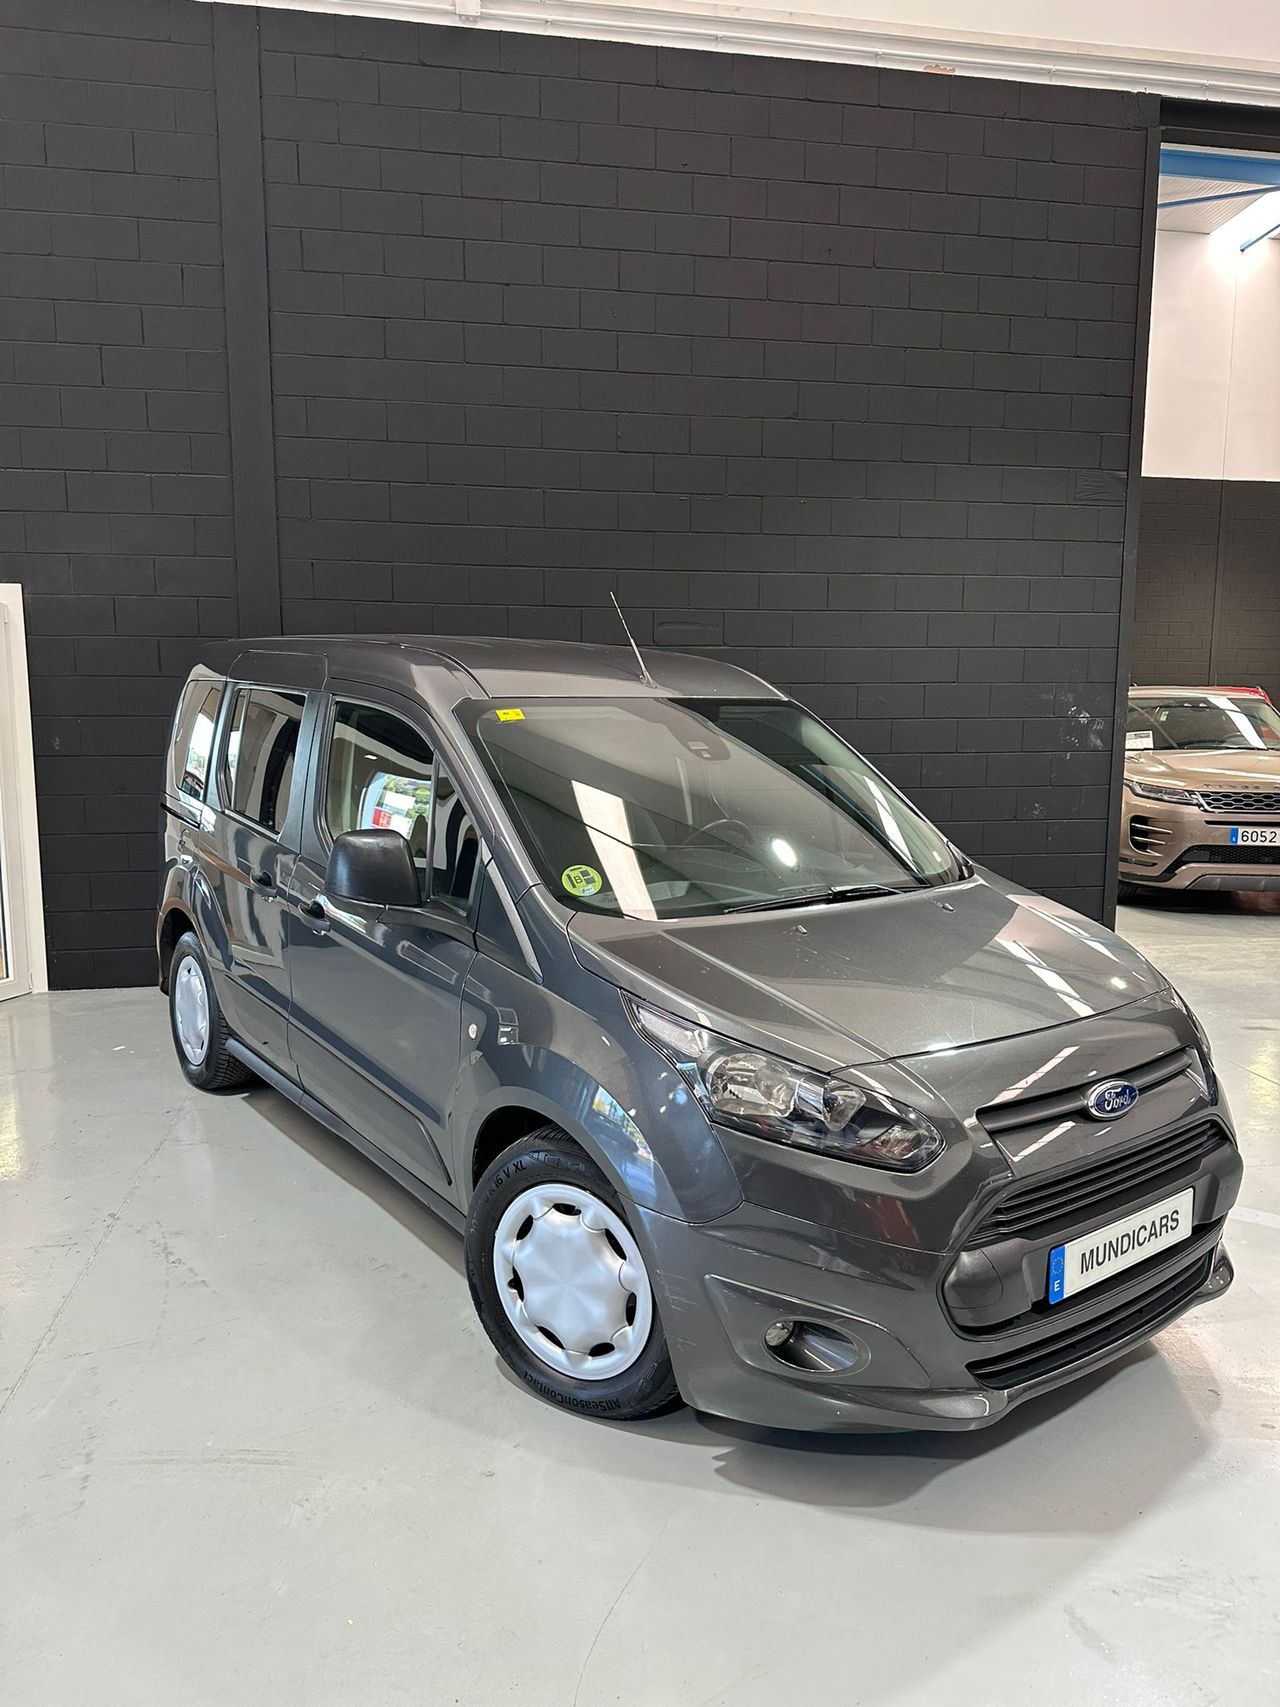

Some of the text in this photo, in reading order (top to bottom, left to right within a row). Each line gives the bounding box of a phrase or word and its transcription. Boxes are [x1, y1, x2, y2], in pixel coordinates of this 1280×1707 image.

[1241, 830, 1277, 843] 6052
[573, 875, 583, 884] B
[1104, 1087, 1136, 1111] Ford
[503, 1168, 511, 1179] V
[512, 1160, 527, 1173] XL
[1080, 1209, 1180, 1275] MUNDICARS
[1054, 1279, 1061, 1292] E
[522, 1370, 622, 1411] AllSeasonContact
